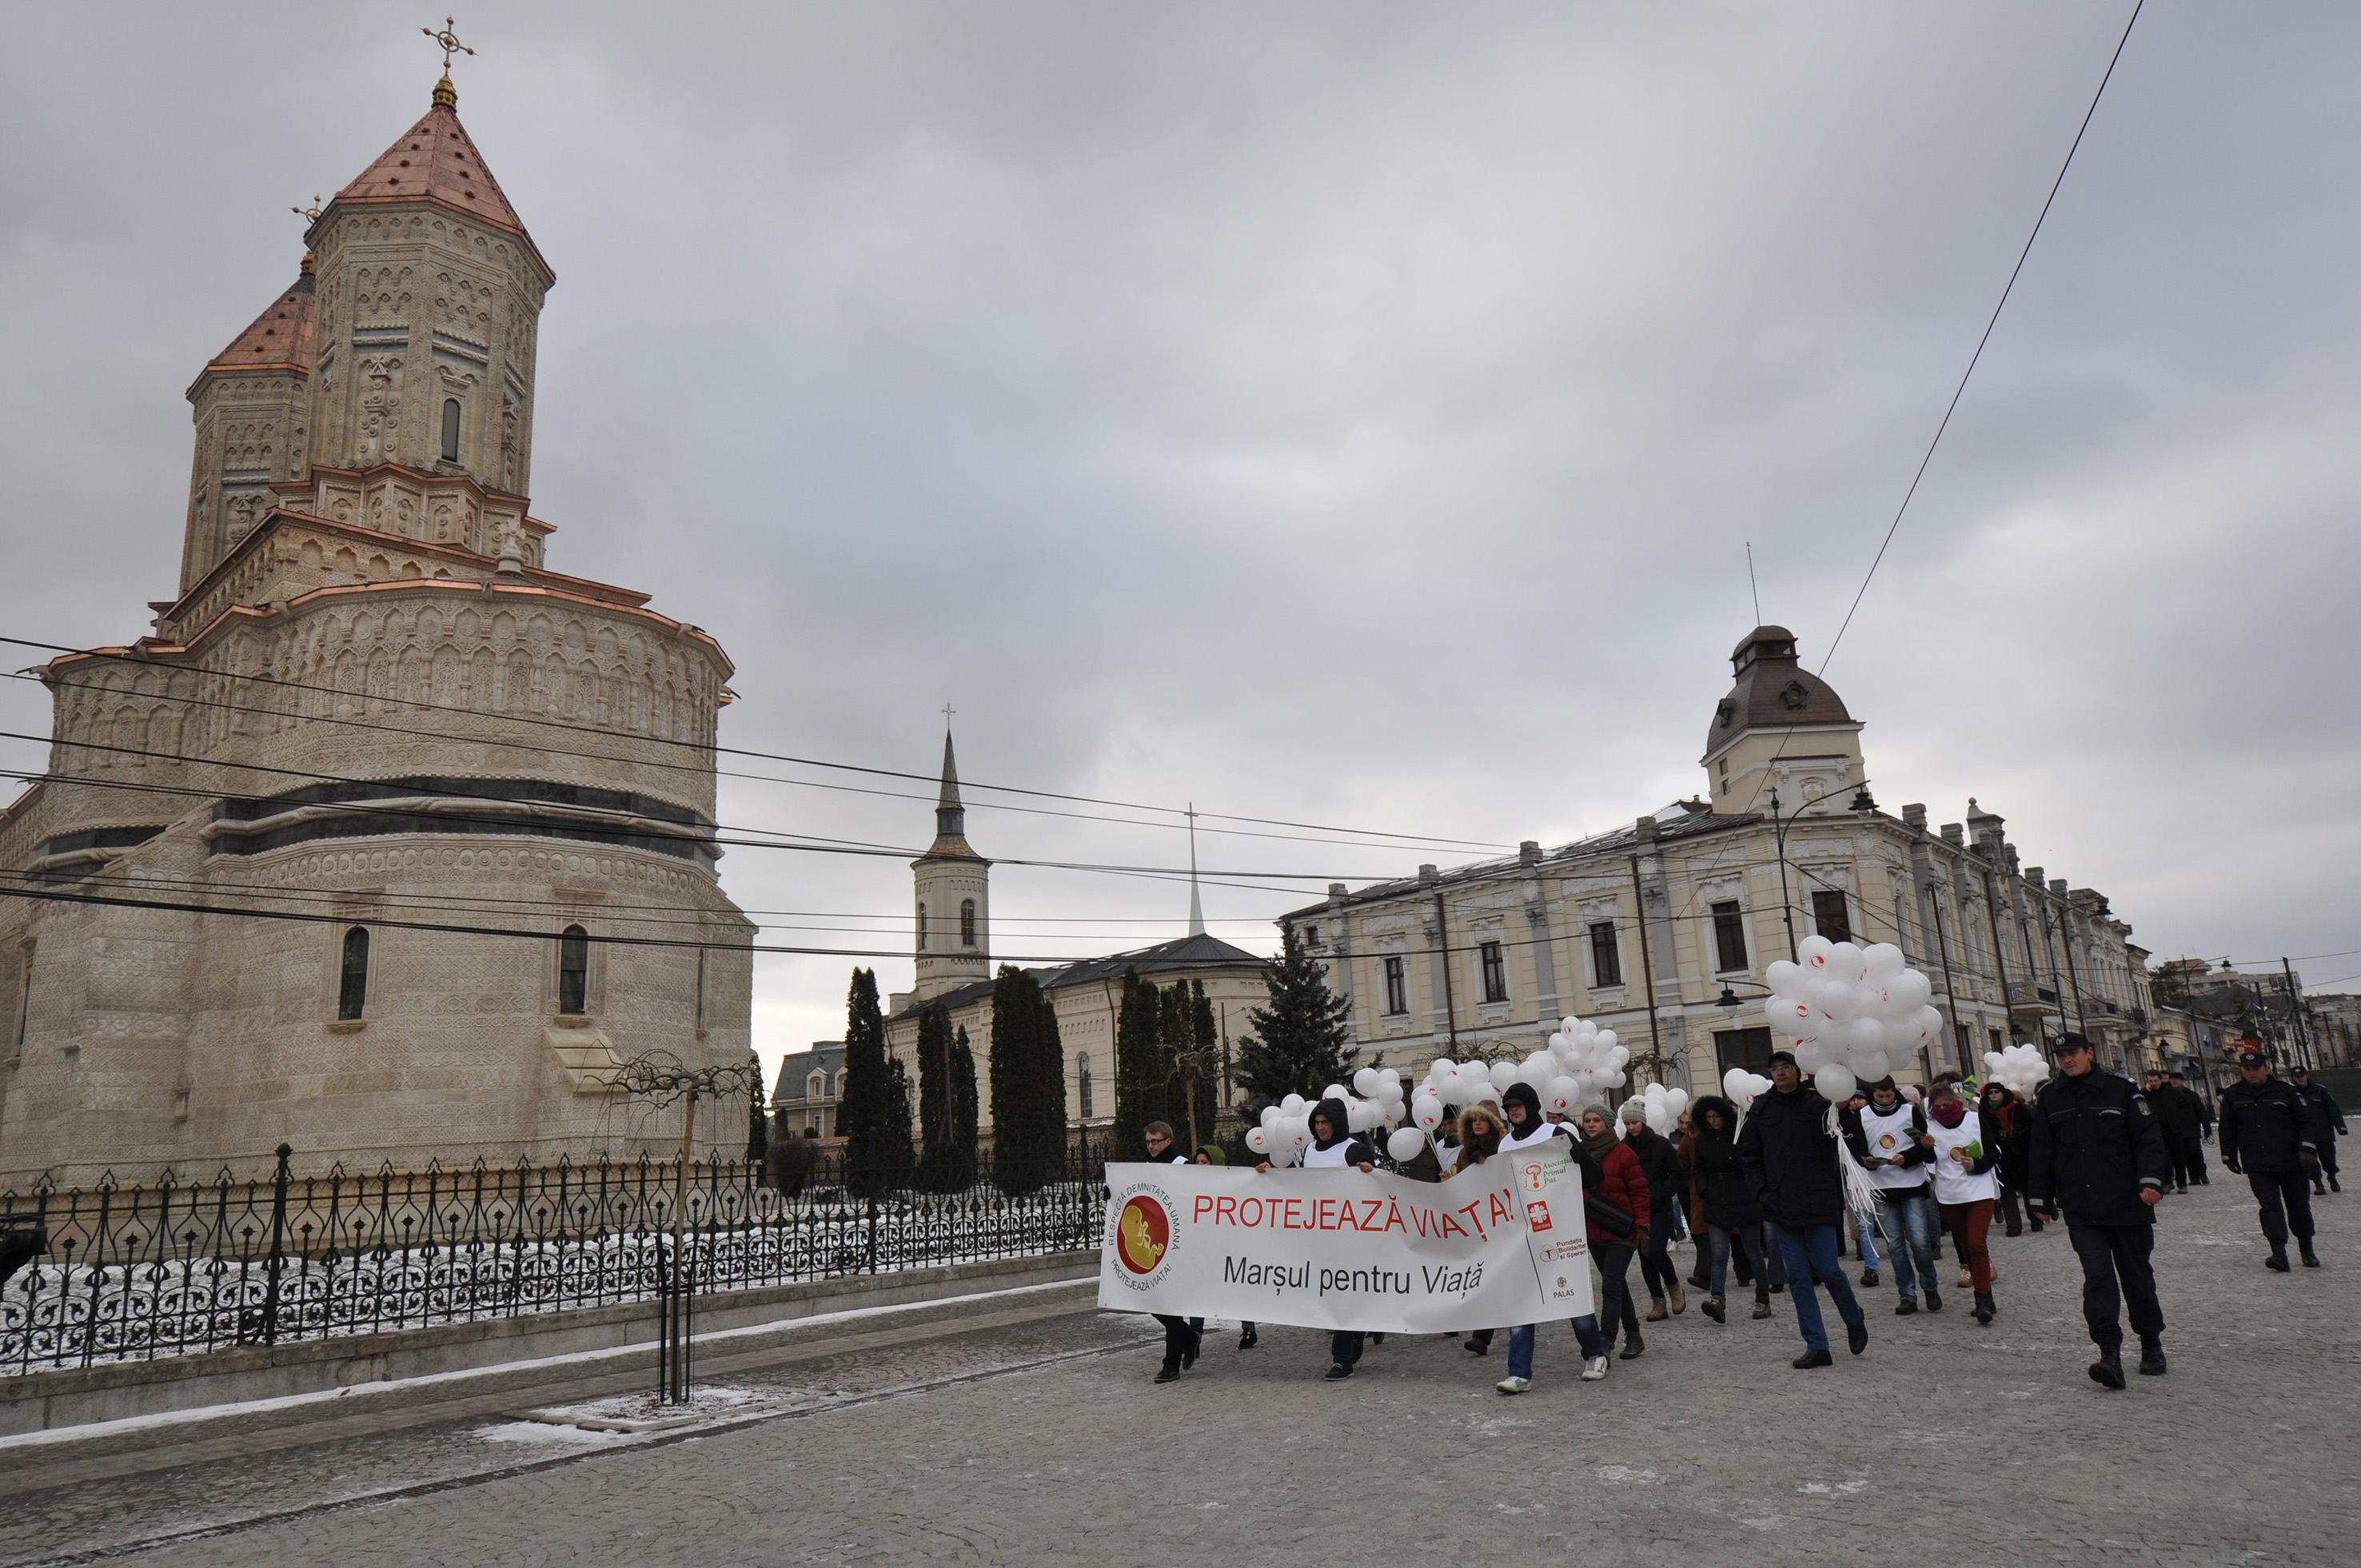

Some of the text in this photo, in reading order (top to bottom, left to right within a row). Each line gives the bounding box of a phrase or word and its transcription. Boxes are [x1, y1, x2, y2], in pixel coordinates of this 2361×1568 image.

[1543, 1166, 1566, 1178] Primul
[1127, 1183, 1173, 1210] DEMNITATEA
[1194, 1188, 1514, 1243] PROTEJEAZĂ VIAȚA!
[1111, 1259, 1151, 1291] PROTEJEAZĂ
[1224, 1255, 1484, 1299] Marșul pentru Viață
[1553, 1289, 1574, 1299] PALAS
